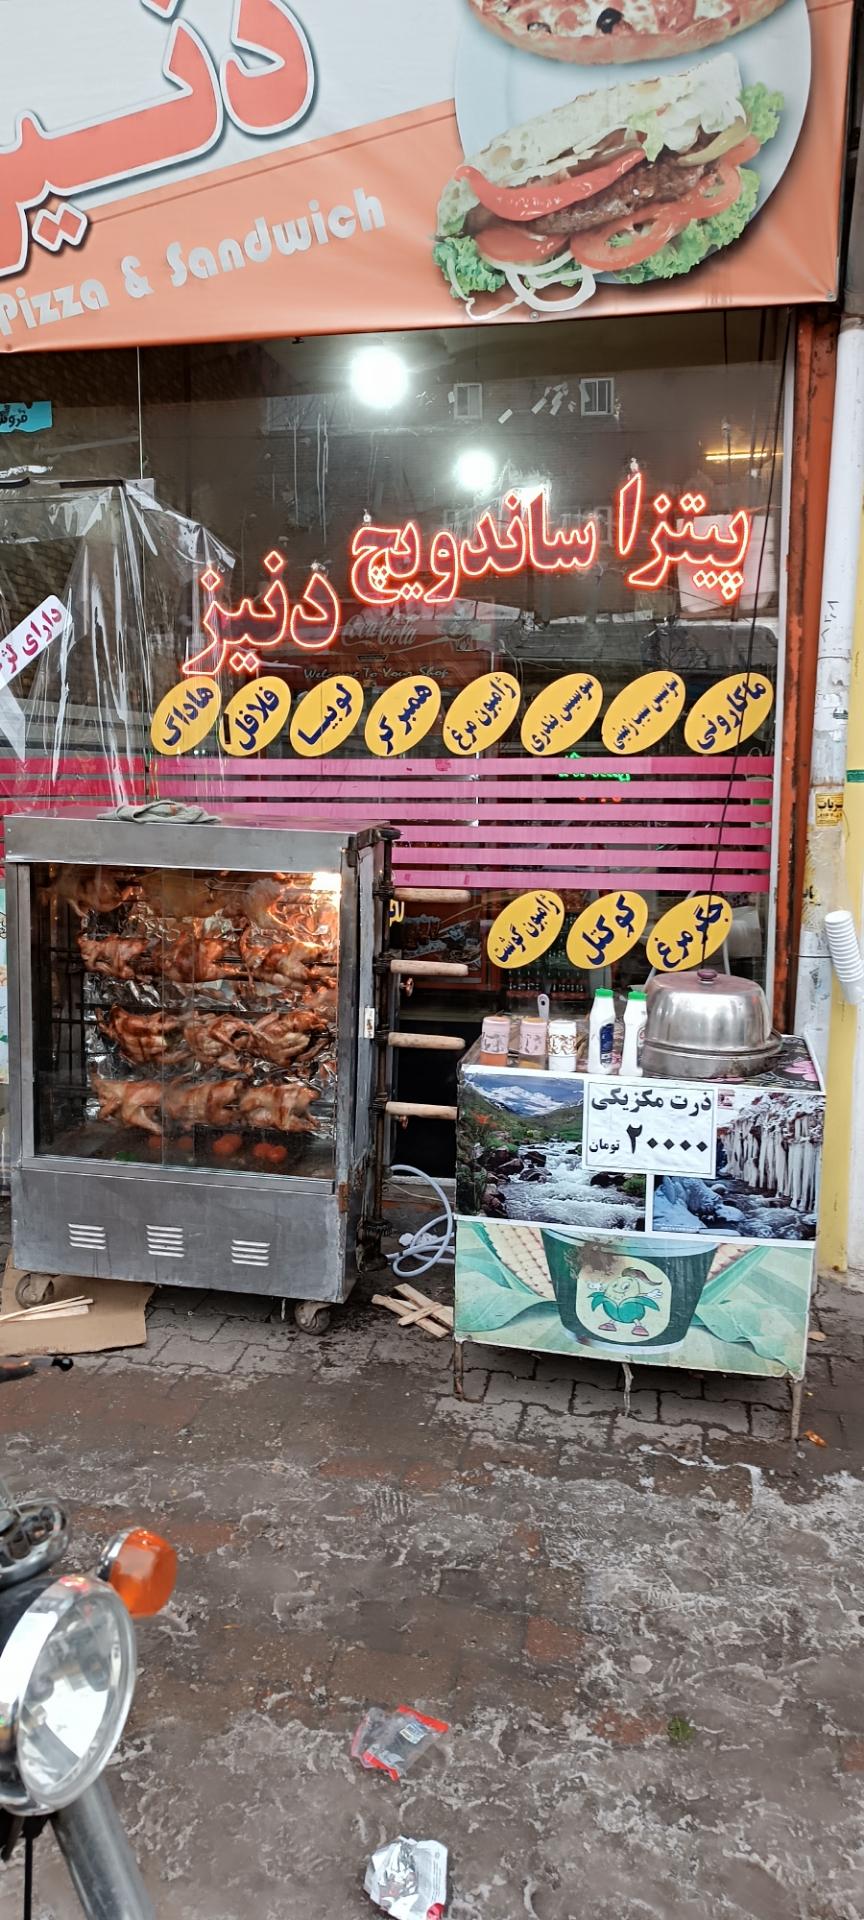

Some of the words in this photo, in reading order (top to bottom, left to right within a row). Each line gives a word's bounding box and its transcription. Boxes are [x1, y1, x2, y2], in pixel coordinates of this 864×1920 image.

[0, 279, 110, 336] Pizza
[121, 256, 154, 299] &
[166, 187, 386, 288] Sandwich
[350, 487, 597, 605] ساندویچ
[618, 472, 750, 600] پیتزا
[22, 608, 63, 656] دارای
[182, 551, 339, 675] دنیز
[341, 614, 417, 646] Coca-Cola
[363, 667, 378, 678] To
[297, 683, 353, 745] لوبیا
[478, 677, 517, 727] ژامبون
[560, 678, 594, 722] سوسیس
[652, 677, 679, 713] سوسیس
[697, 680, 767, 751] ماکارونی
[235, 686, 280, 751] فلافل
[446, 720, 477, 751] مرغ
[531, 713, 564, 752] بندری
[526, 893, 561, 938] ژامبون
[693, 903, 729, 944] جگر
[494, 923, 526, 962] گوشت
[655, 931, 693, 968] مرغ
[592, 1088, 664, 1113] مکزیکی
[670, 1091, 711, 1116] ذرت
[589, 1138, 621, 1154] تومان
[626, 1124, 708, 1154] ۲۰۰۰۰
